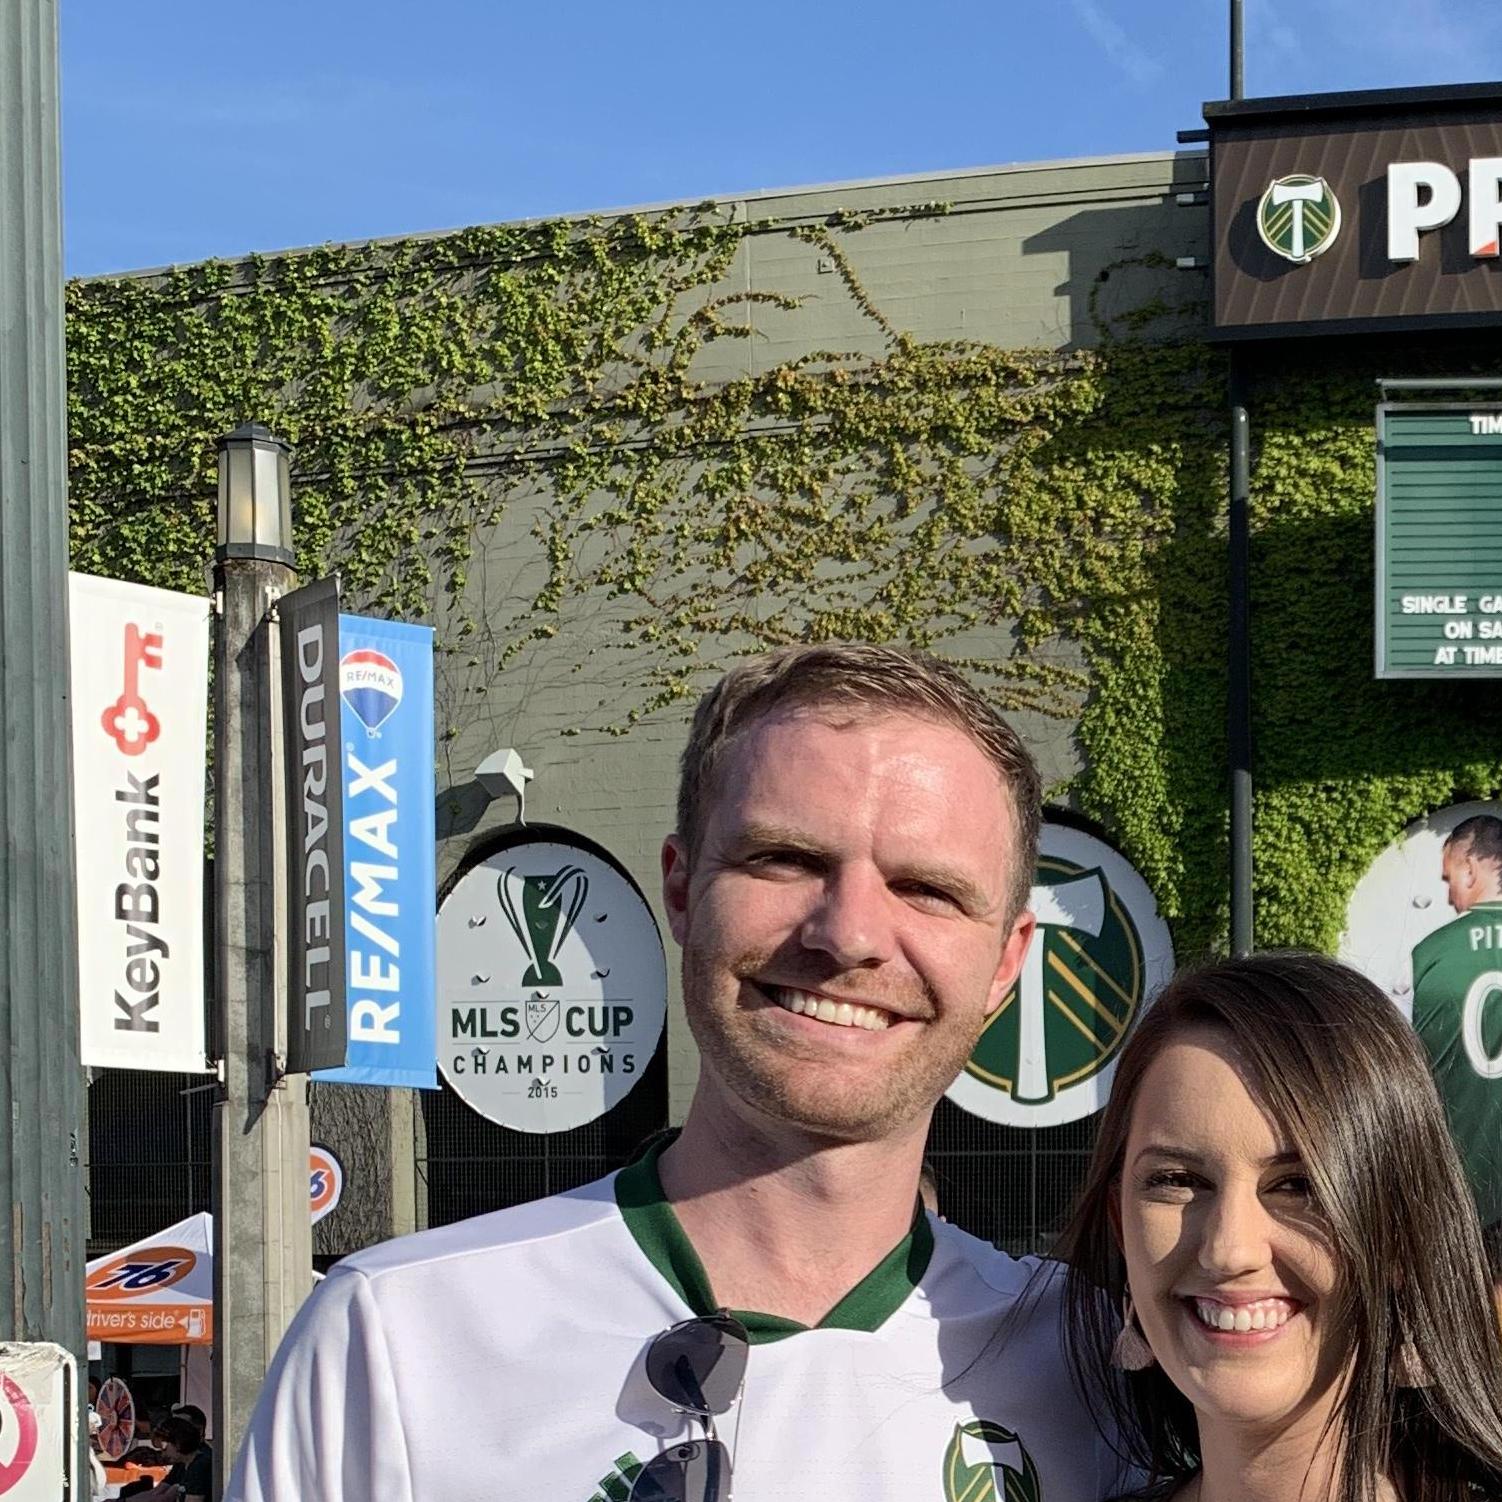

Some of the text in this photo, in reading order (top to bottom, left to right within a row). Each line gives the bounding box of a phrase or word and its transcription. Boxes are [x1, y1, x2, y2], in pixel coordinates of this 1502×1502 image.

[1401, 596, 1469, 615] SINGLE
[1444, 620, 1473, 640] ON
[1433, 646, 1457, 665] AT
[346, 670, 396, 689] RE/MAX
[297, 625, 331, 1033] DURACELL
[113, 771, 170, 1035] KeyBank
[347, 756, 401, 1045] RE/MAX
[528, 1003, 547, 1014] MLS
[451, 1005, 634, 1038] MLS CUP
[453, 1053, 636, 1075] CHAMPIONS
[527, 1086, 559, 1099] 2015
[310, 1169, 329, 1200] 6
[140, 1311, 175, 1329] side
